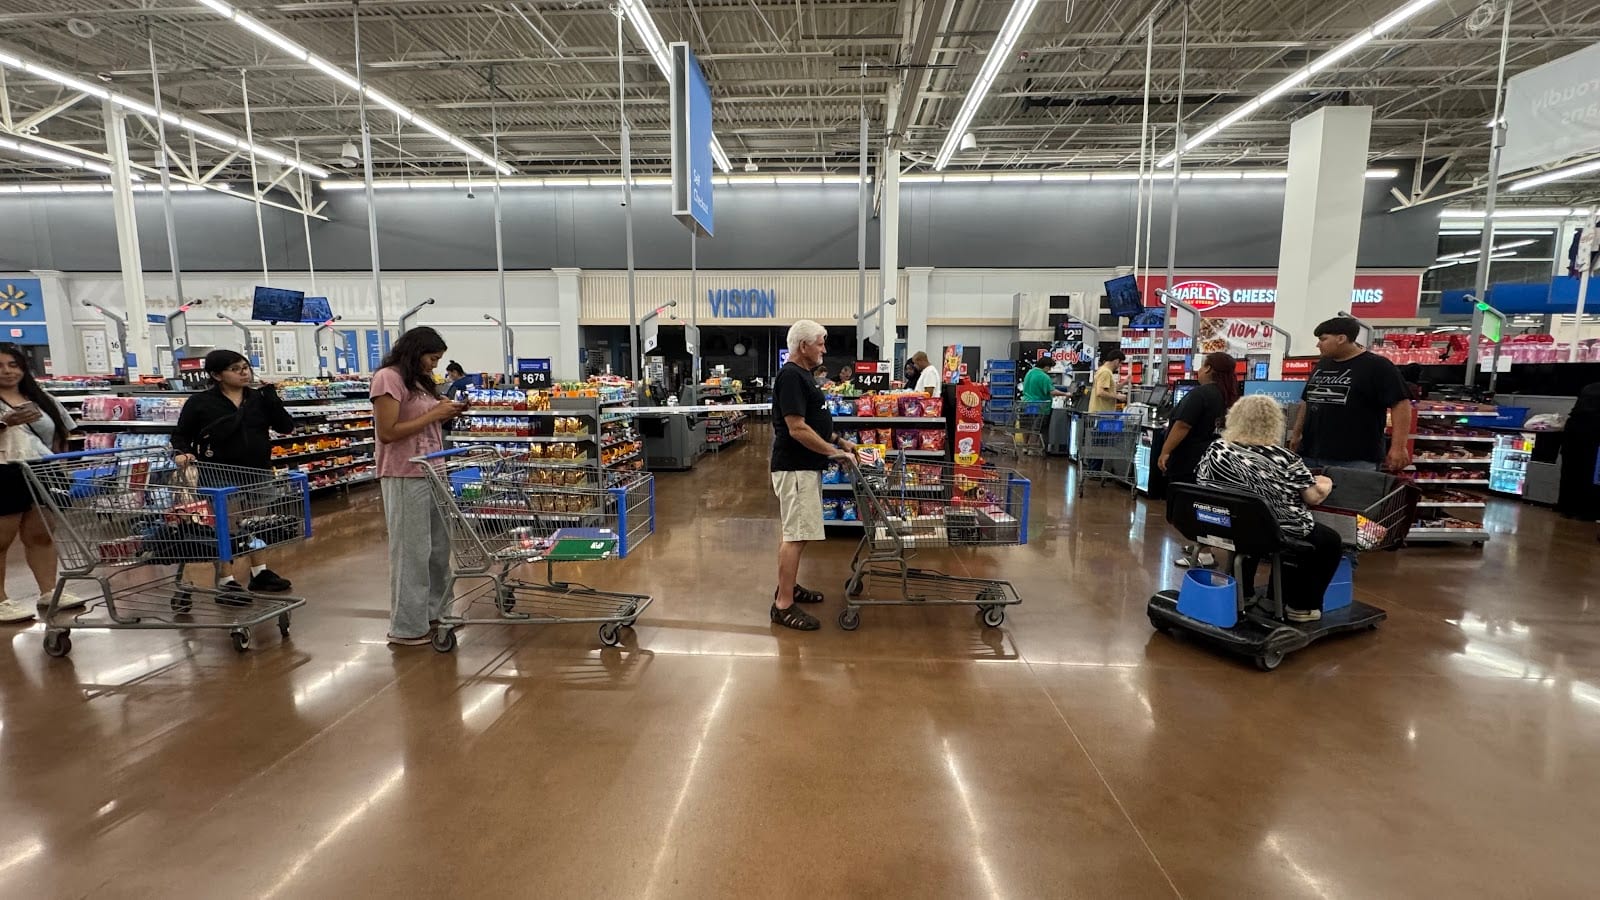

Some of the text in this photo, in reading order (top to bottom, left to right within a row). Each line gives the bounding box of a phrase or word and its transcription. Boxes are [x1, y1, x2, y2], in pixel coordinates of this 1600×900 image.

[1233, 289, 1278, 303] CHEES
[1351, 289, 1384, 303] INGS
[708, 289, 776, 318] VISION
[1227, 323, 1260, 338] NOW
[110, 341, 120, 350] 16
[175, 338, 184, 346] 13
